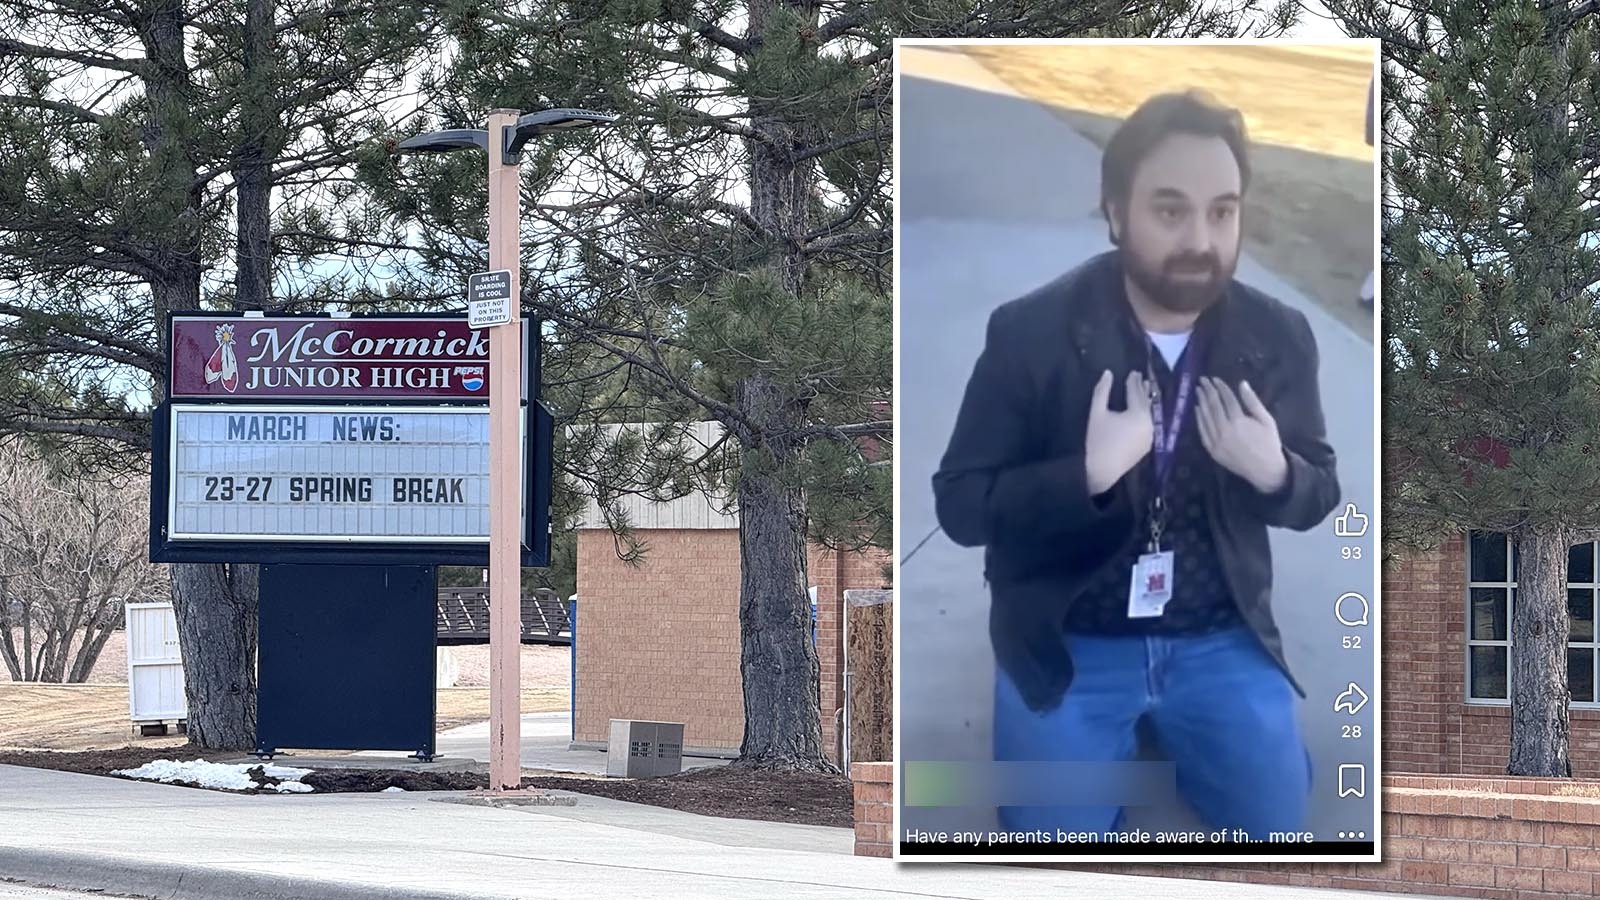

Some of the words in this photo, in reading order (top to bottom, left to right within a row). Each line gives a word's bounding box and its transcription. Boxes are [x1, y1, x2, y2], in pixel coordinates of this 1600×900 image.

[475, 282, 506, 290] BOARDING
[247, 322, 490, 363] McCormick
[245, 366, 361, 389] JUNIOR
[370, 367, 451, 389] HIGH
[453, 367, 484, 376] PEPSI
[228, 416, 306, 441] MARCH
[332, 416, 401, 442] NEWS:
[205, 477, 273, 502] 23-27
[290, 477, 372, 503] SPRING
[393, 478, 464, 504] BREAK
